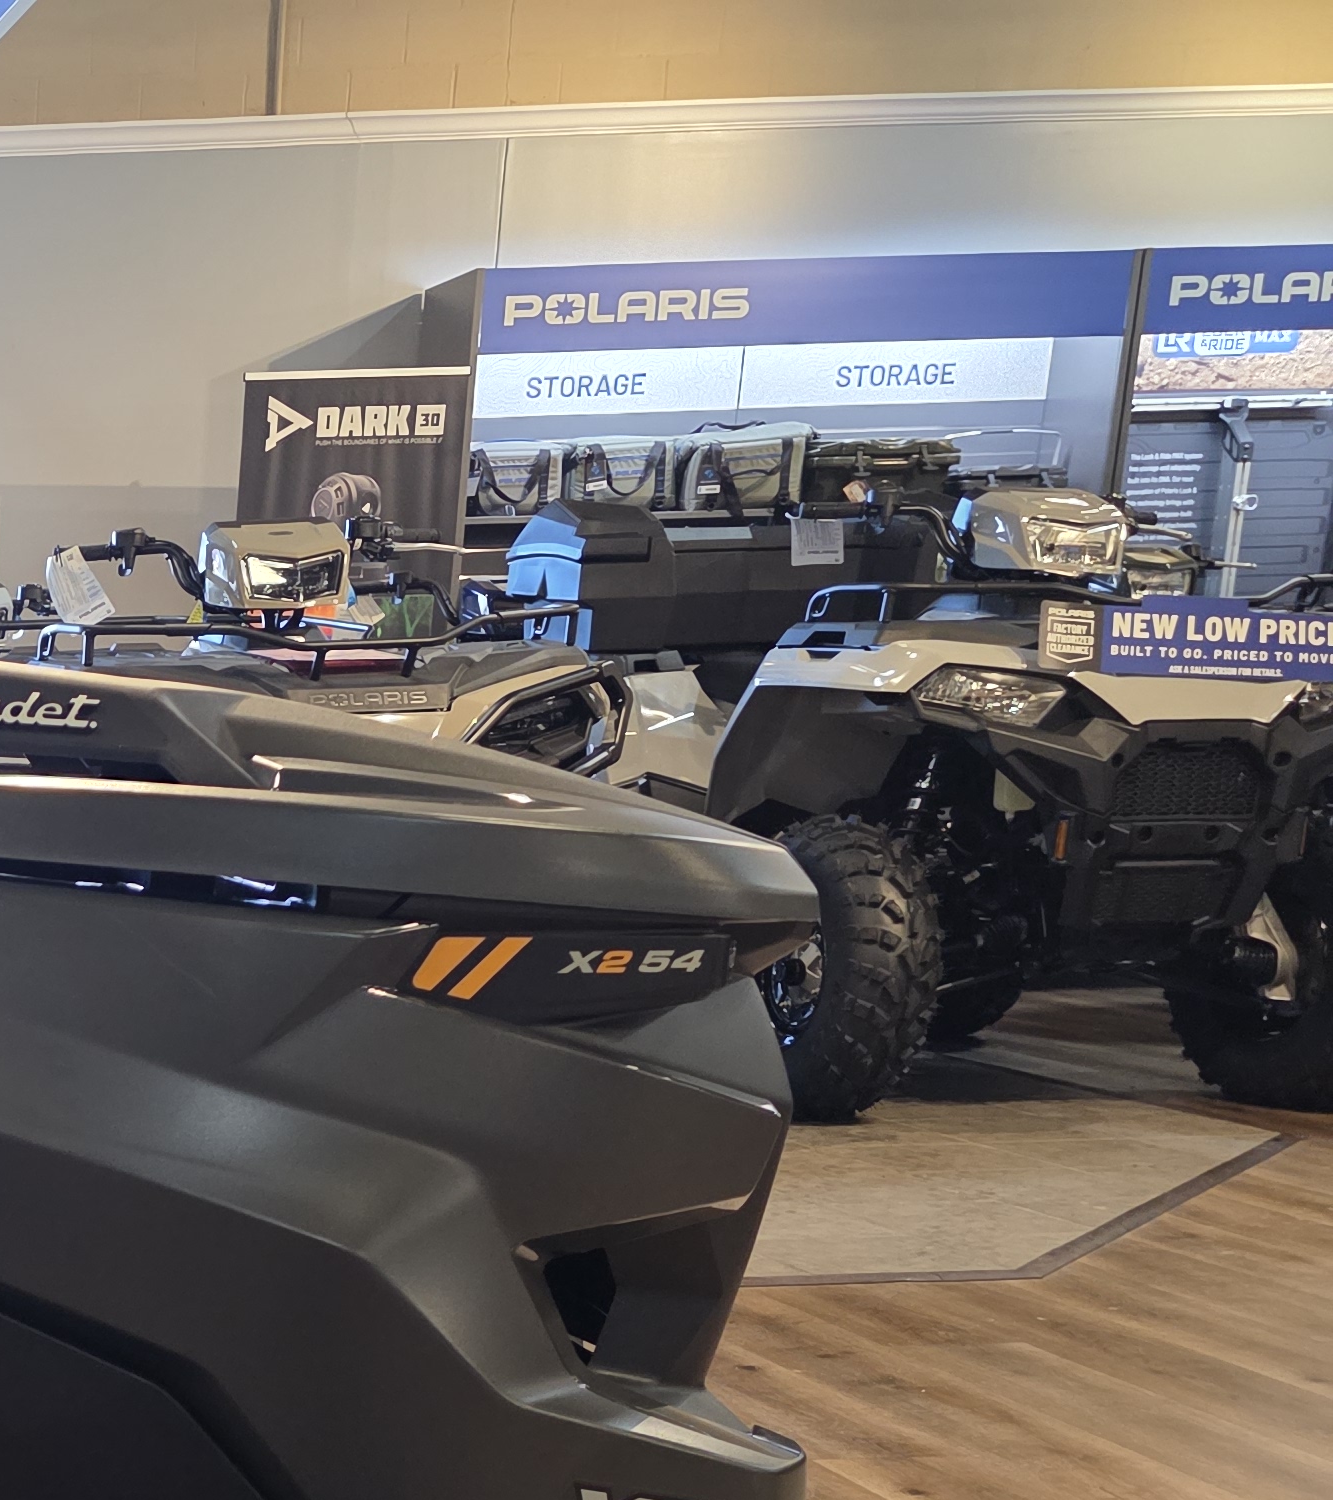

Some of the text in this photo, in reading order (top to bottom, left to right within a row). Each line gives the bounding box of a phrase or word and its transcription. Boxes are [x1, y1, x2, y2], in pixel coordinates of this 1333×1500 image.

[1169, 270, 1333, 307] POLA
[503, 287, 750, 328] POLARIS
[525, 372, 648, 400] STORAGE
[835, 361, 958, 388] STORAGE
[316, 404, 412, 438] DARK
[1046, 632, 1095, 646] AUTHORIZED
[1053, 622, 1088, 635] FACTORY
[1112, 612, 1179, 640] NEW
[1186, 615, 1251, 643] LOW
[1049, 643, 1090, 655] CLEARANCE
[1110, 644, 1154, 657] BUILT
[1158, 646, 1178, 658] TO
[1182, 648, 1208, 660] GO.
[1213, 649, 1269, 662] PRICED
[1274, 651, 1293, 663] TO
[309, 690, 428, 707] POLARIS
[556, 949, 706, 974] X2 54
